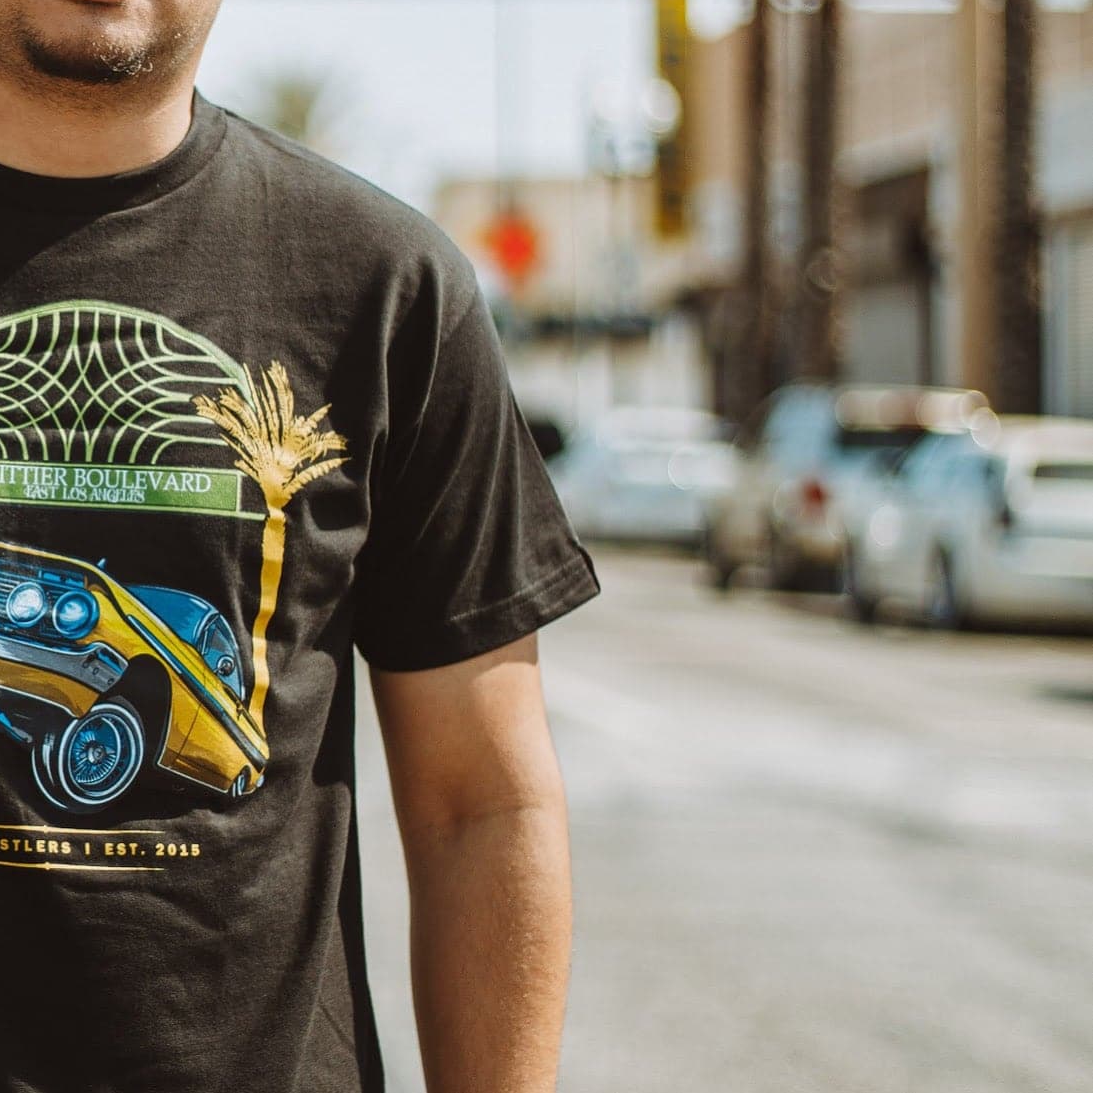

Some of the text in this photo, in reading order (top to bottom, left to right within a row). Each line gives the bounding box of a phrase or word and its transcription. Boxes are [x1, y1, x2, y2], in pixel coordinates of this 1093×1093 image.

[73, 468, 212, 493] BOULEVARD
[23, 485, 145, 503] EAST LOS ANGELES
[104, 842, 146, 856] EST.
[155, 843, 201, 857] 2015
